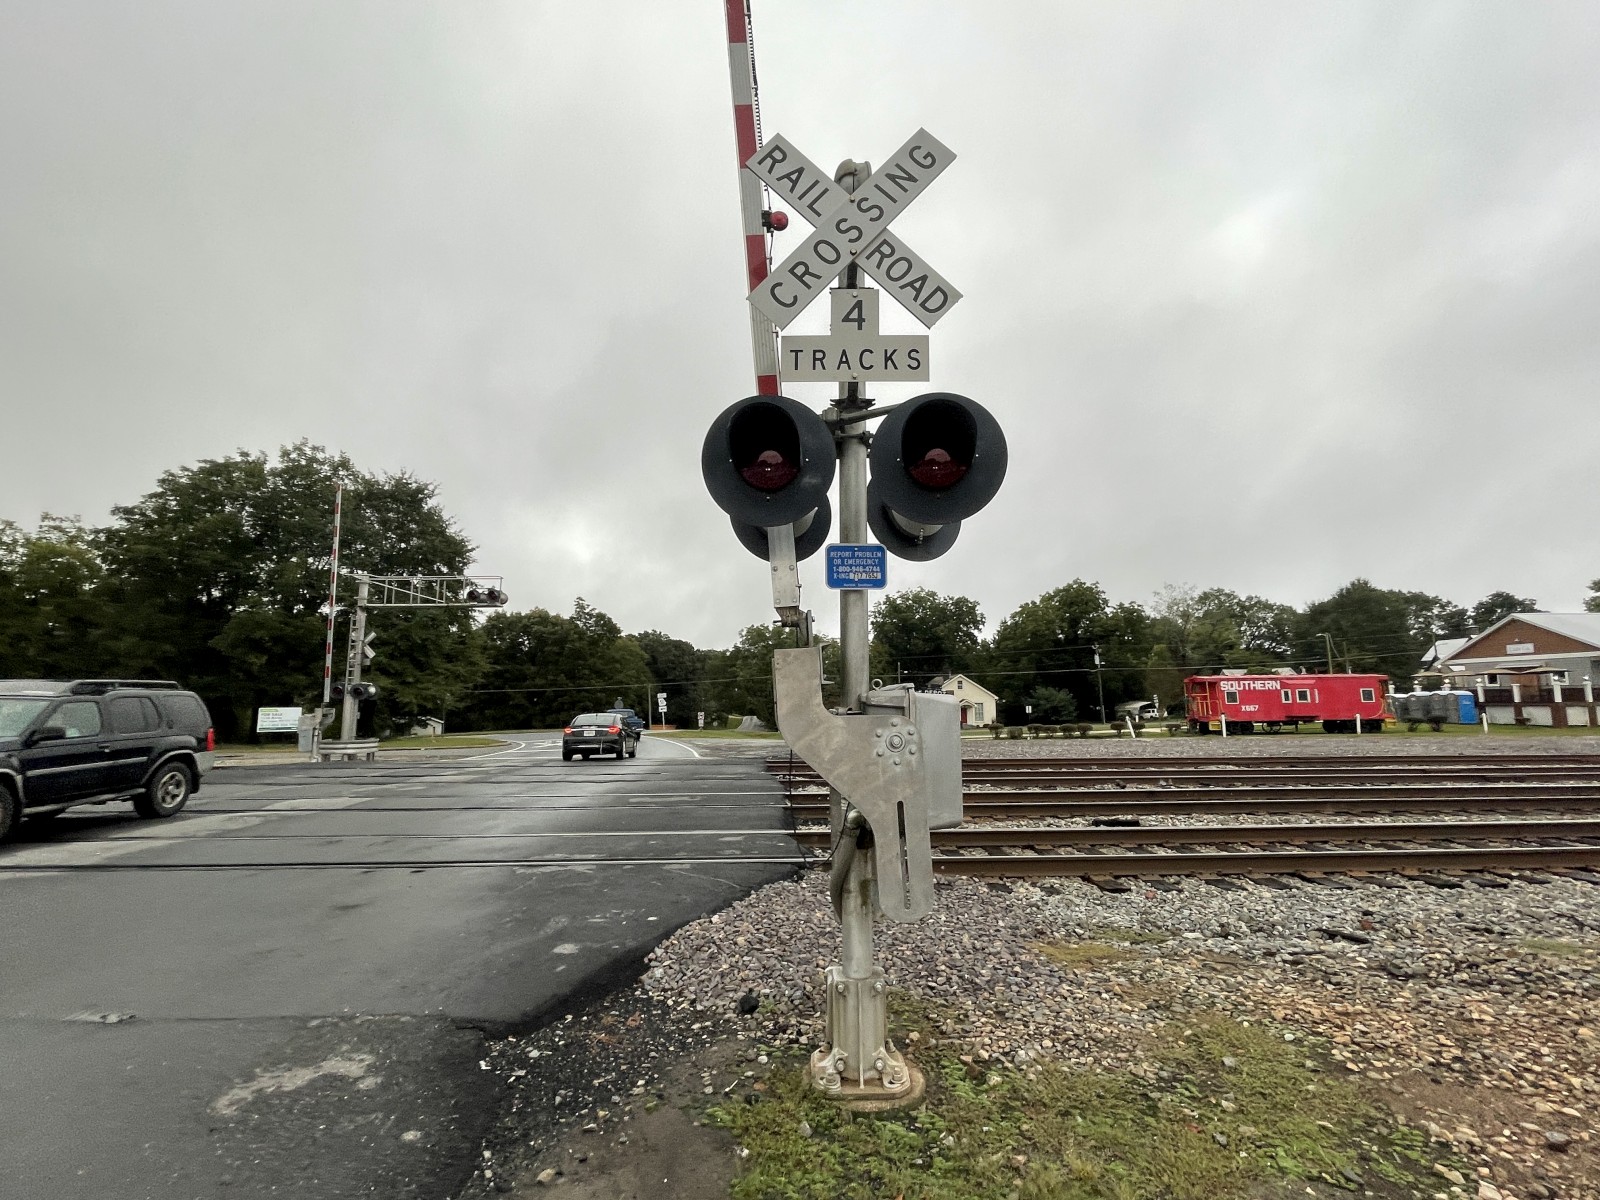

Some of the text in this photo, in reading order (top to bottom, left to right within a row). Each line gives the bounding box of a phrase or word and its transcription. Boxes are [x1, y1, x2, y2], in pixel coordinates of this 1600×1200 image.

[757, 144, 949, 314] RAIL ROAD
[769, 145, 937, 309] CROSSING
[841, 299, 866, 331] 4
[789, 348, 922, 371] TRACKS
[833, 565, 880, 573] 1-800-946-4744
[1220, 680, 1281, 690] SOUTHERN
